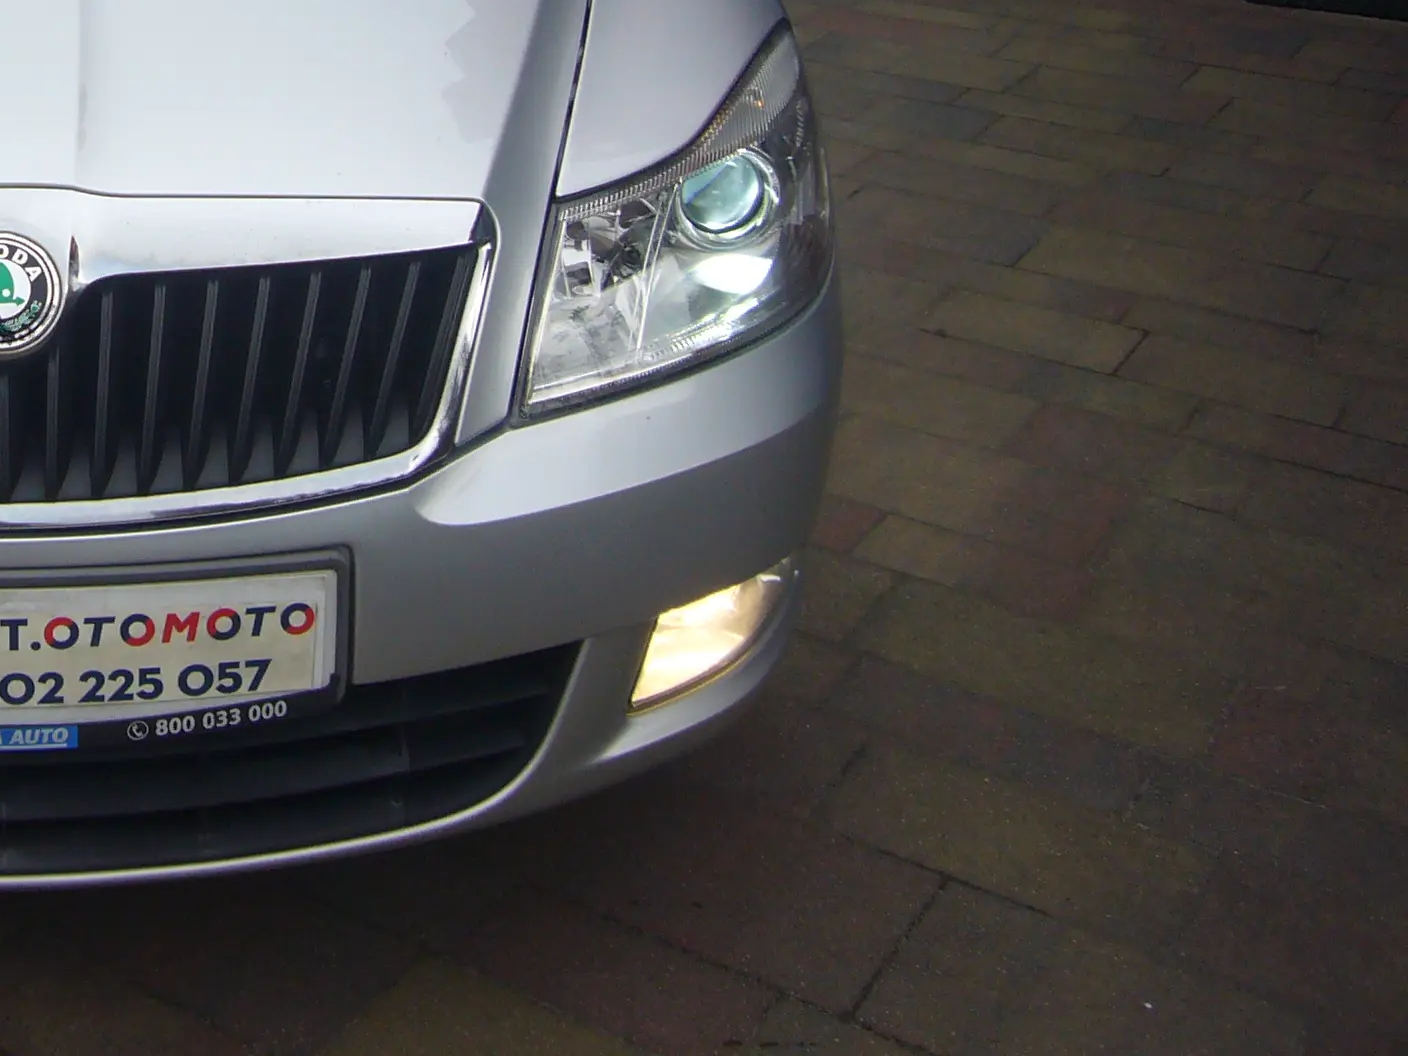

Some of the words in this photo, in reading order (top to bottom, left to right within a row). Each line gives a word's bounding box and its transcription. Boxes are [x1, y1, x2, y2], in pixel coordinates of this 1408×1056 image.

[78, 665, 165, 703] 225
[176, 658, 273, 696] 057
[9, 727, 70, 747] AUTO
[155, 713, 196, 737] 800
[201, 707, 243, 732] 033
[247, 701, 288, 727] 000
